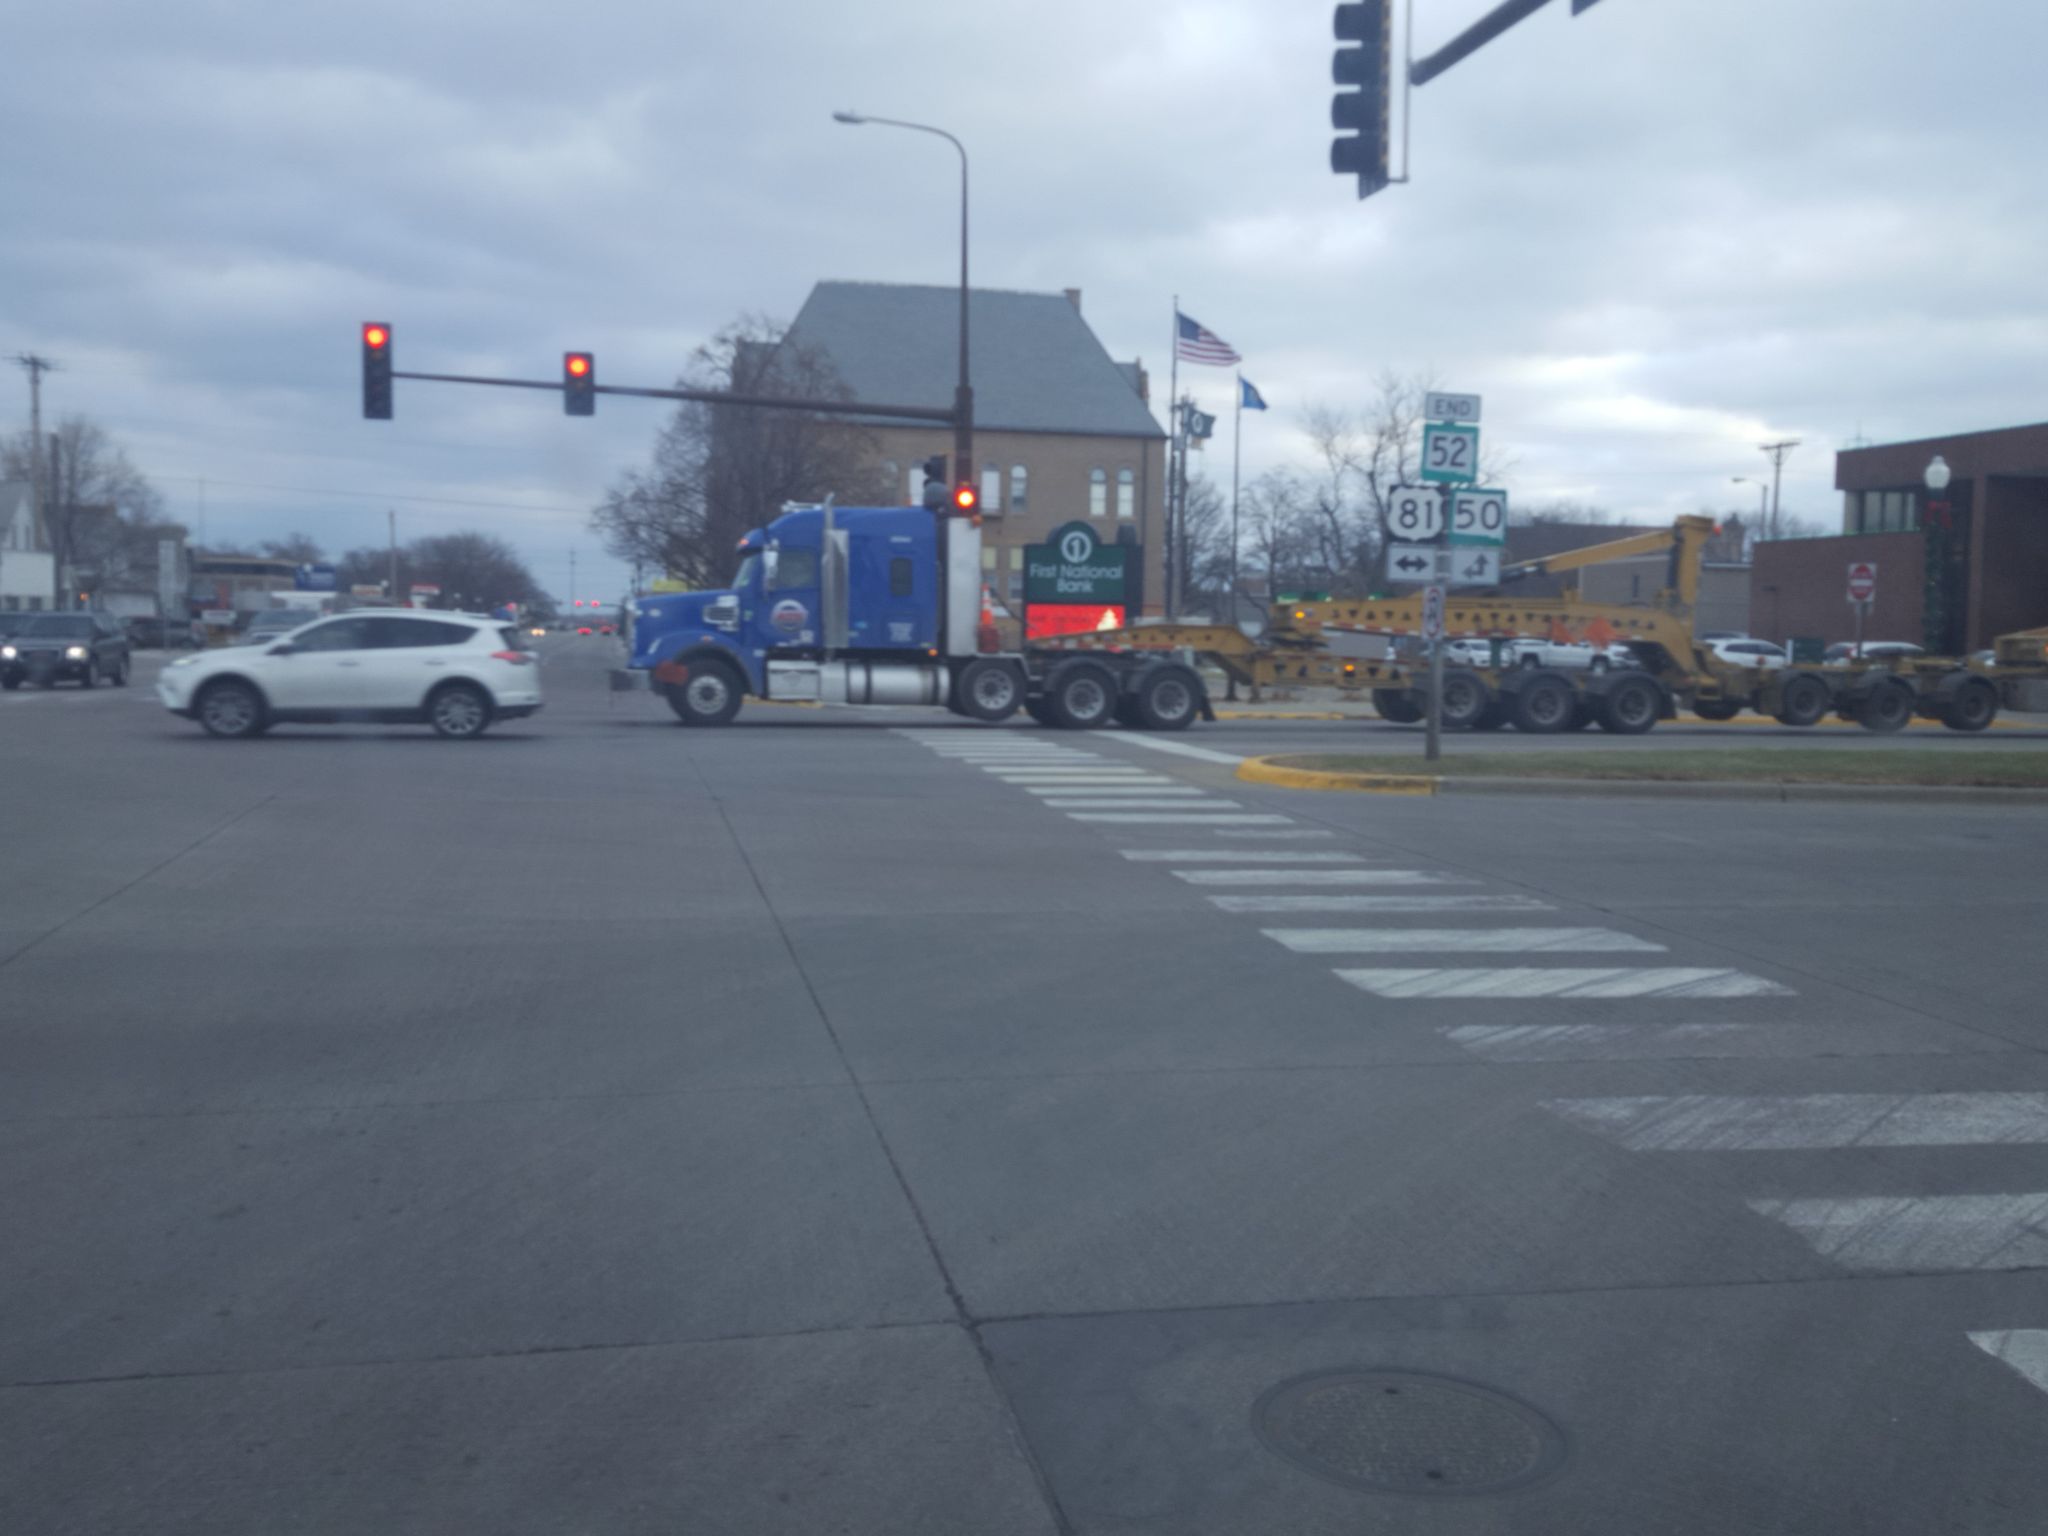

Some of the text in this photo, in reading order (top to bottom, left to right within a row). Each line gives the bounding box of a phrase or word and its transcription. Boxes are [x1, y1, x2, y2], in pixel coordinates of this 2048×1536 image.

[1434, 400, 1471, 416] END
[1431, 436, 1467, 467] 52
[1399, 499, 1433, 529] 81
[1455, 499, 1501, 530] 50
[1029, 564, 1123, 579] First National
[1057, 579, 1094, 593] Bank
